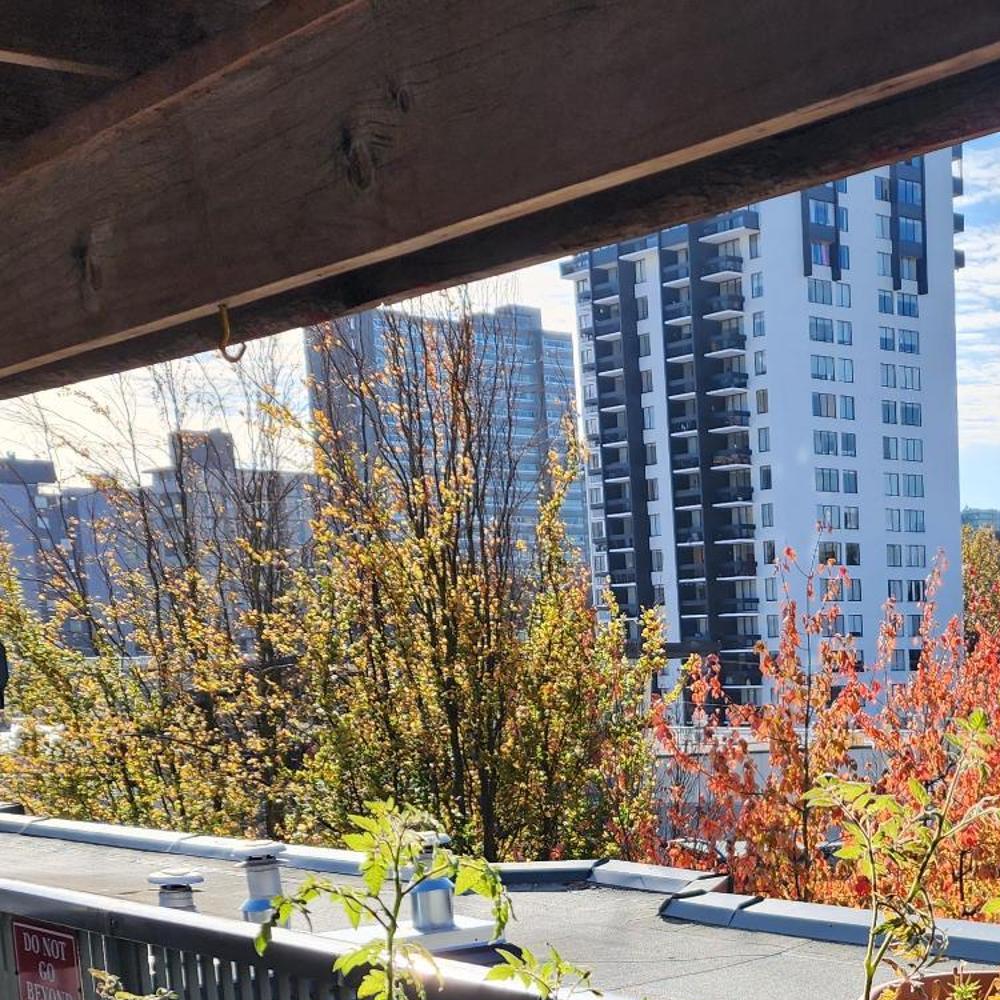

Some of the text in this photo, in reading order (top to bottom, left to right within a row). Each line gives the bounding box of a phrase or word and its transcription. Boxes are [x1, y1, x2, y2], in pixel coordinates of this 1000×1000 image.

[23, 932, 66, 961] DO NOT
[38, 961, 55, 982] GO
